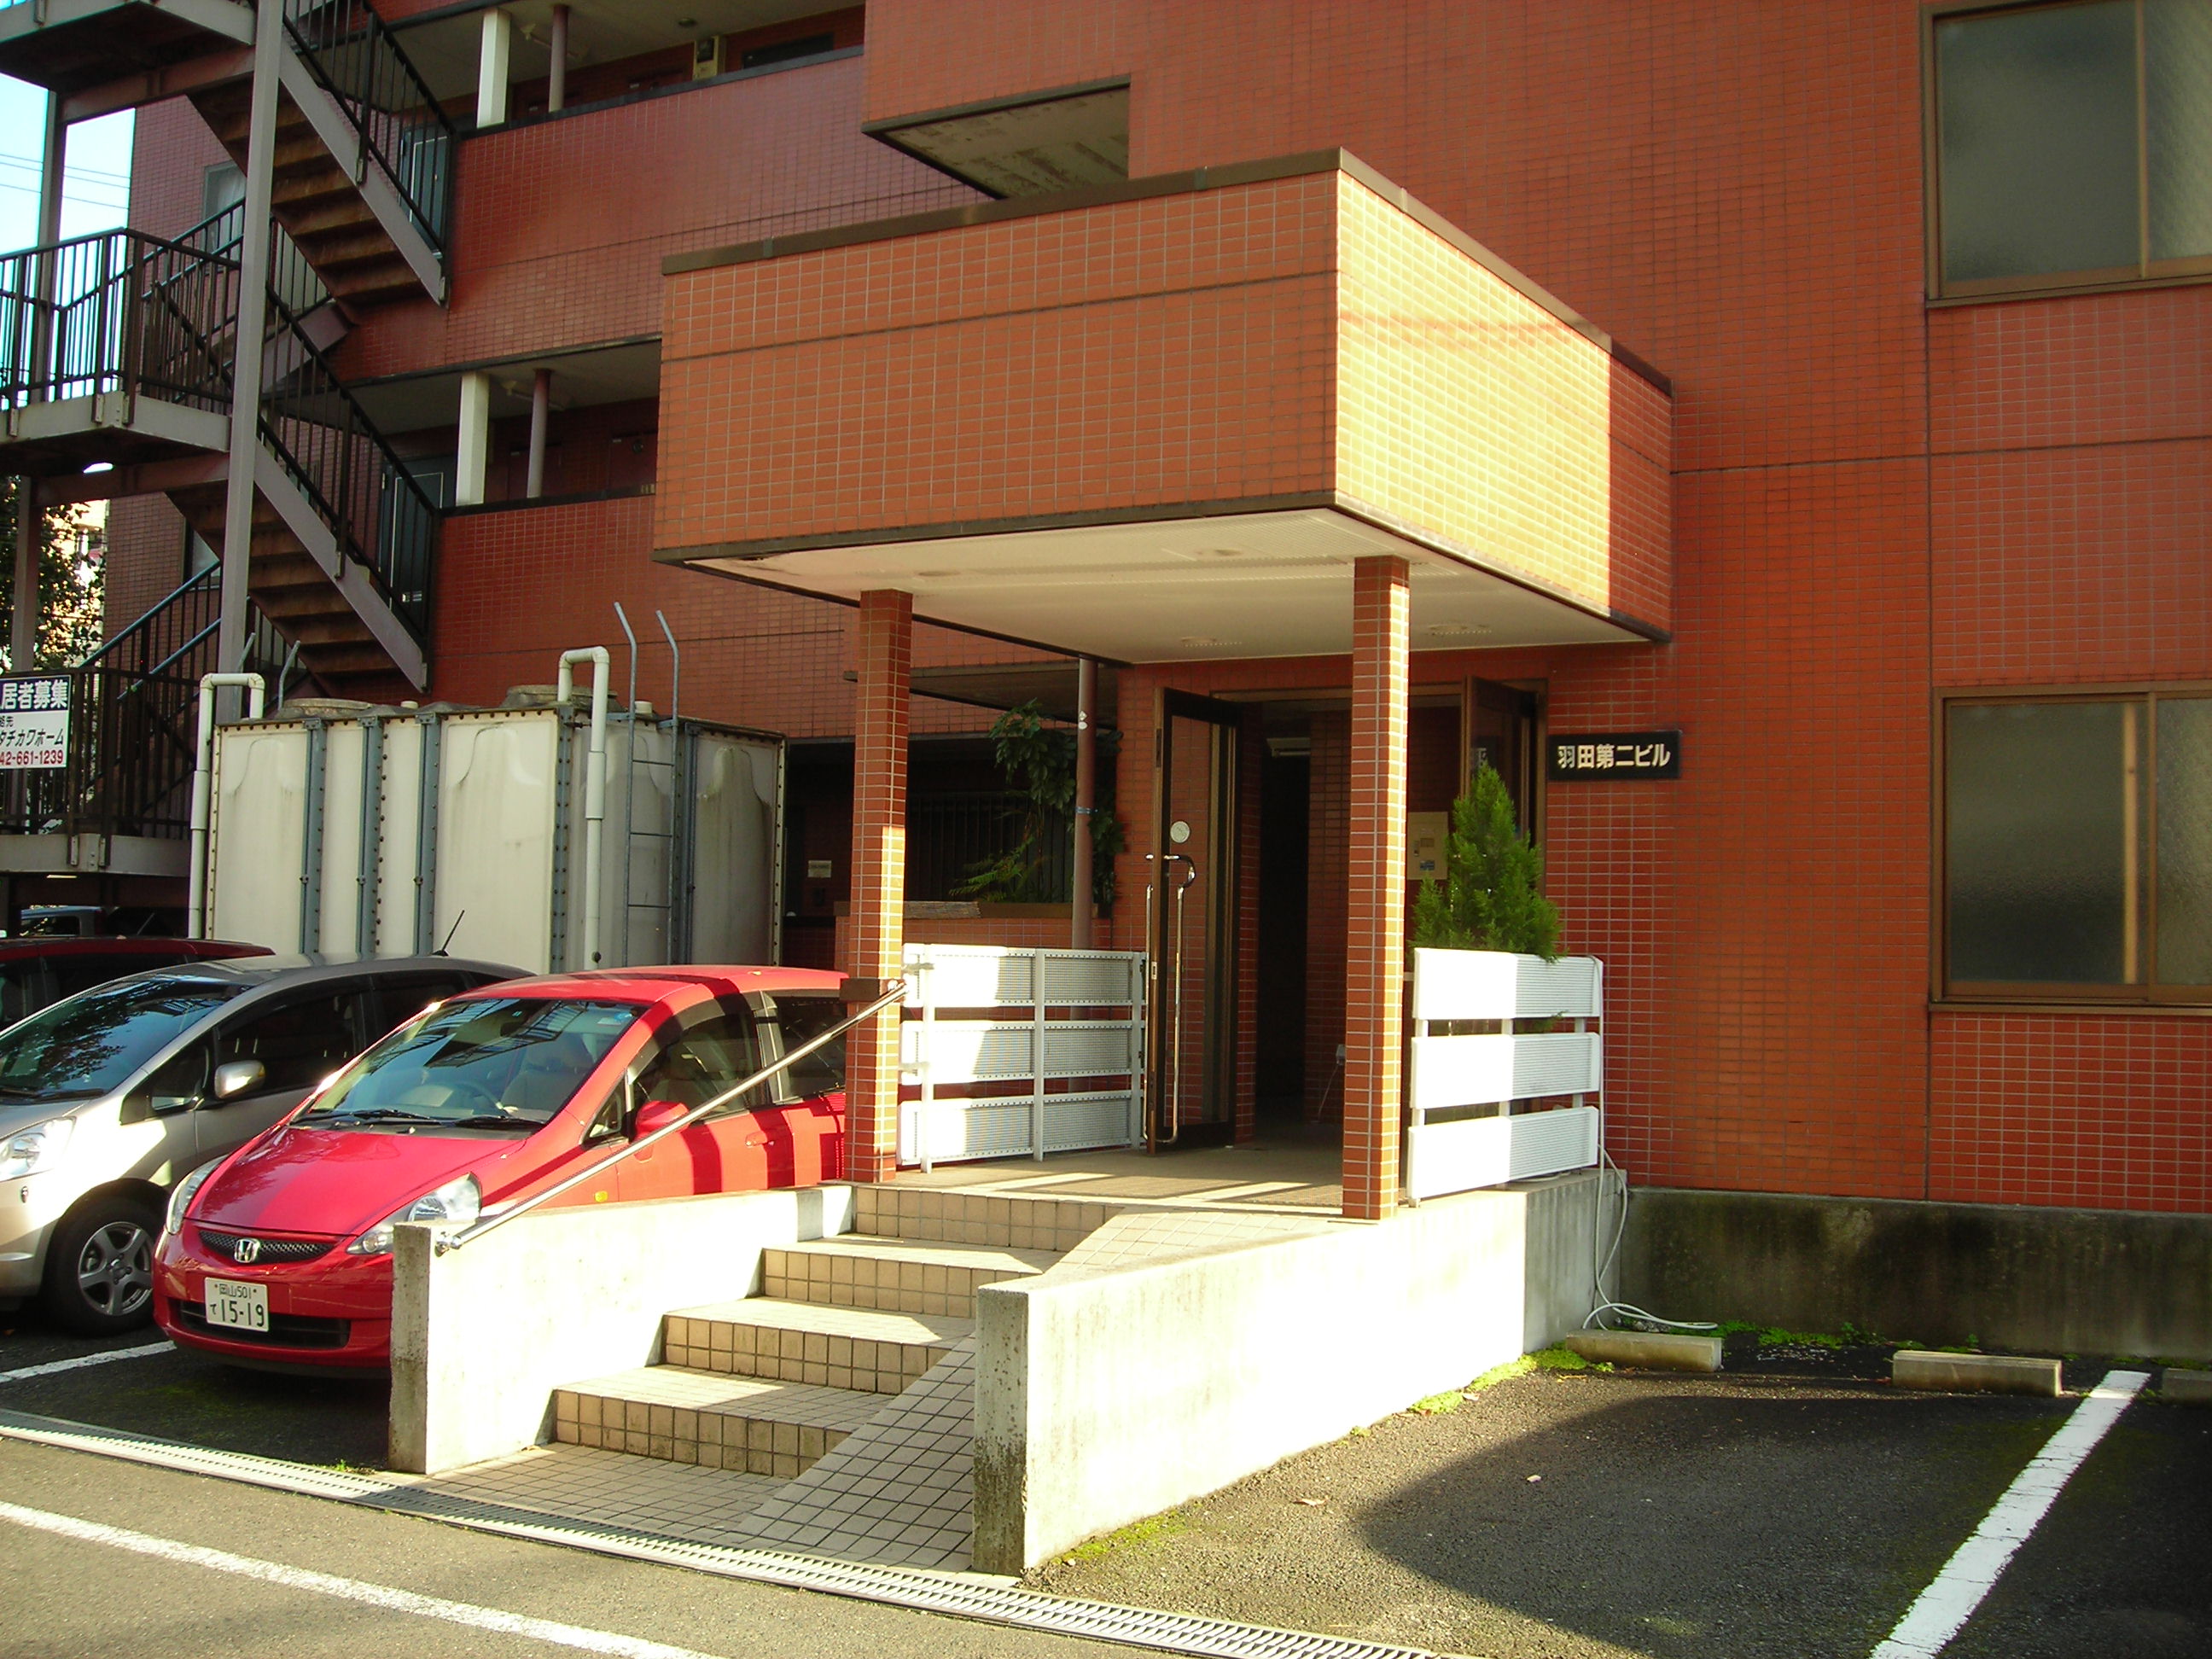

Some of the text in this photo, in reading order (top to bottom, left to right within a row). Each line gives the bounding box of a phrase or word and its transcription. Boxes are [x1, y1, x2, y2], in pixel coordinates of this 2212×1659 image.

[2, 679, 68, 709] 居者募集
[1557, 743, 1671, 769] 羽田第二ビル
[221, 1299, 265, 1327] 15-19
